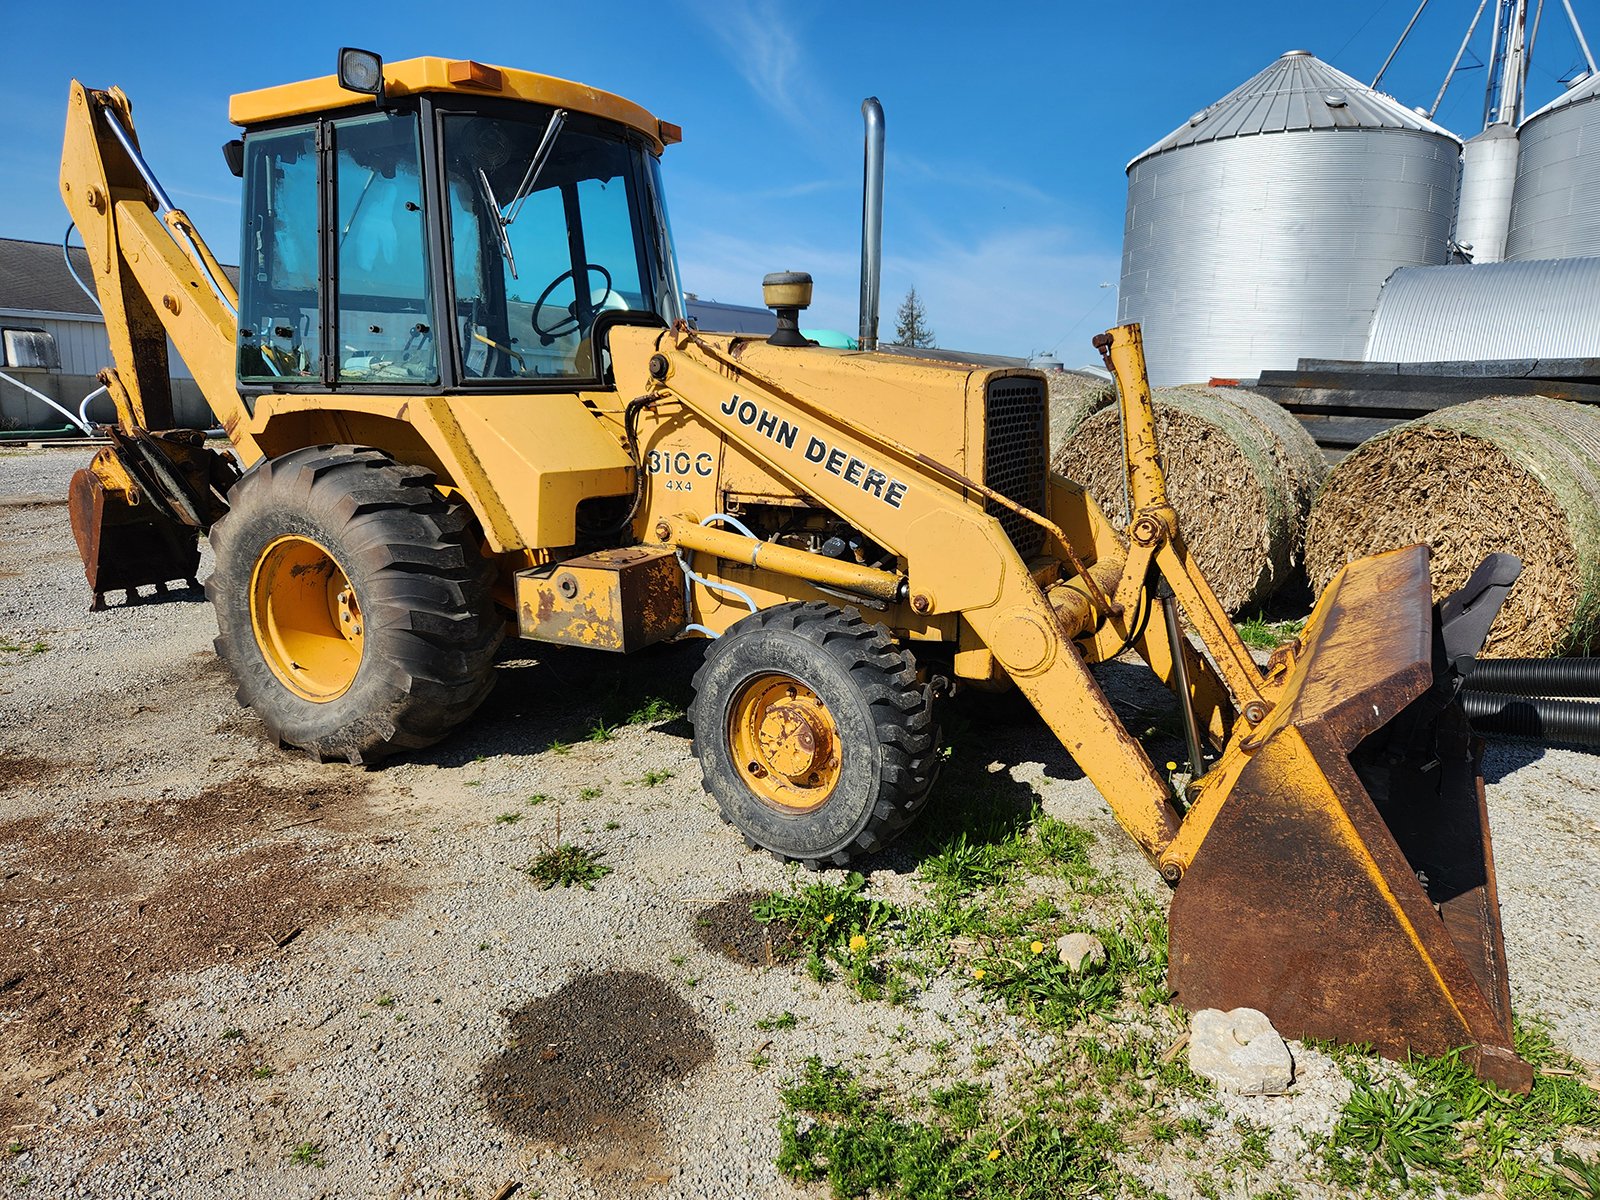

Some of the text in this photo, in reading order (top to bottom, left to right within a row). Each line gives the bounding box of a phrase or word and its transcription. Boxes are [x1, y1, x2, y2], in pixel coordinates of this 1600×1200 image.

[647, 450, 713, 477] 310C
[720, 393, 908, 509] JOHN DEERE
